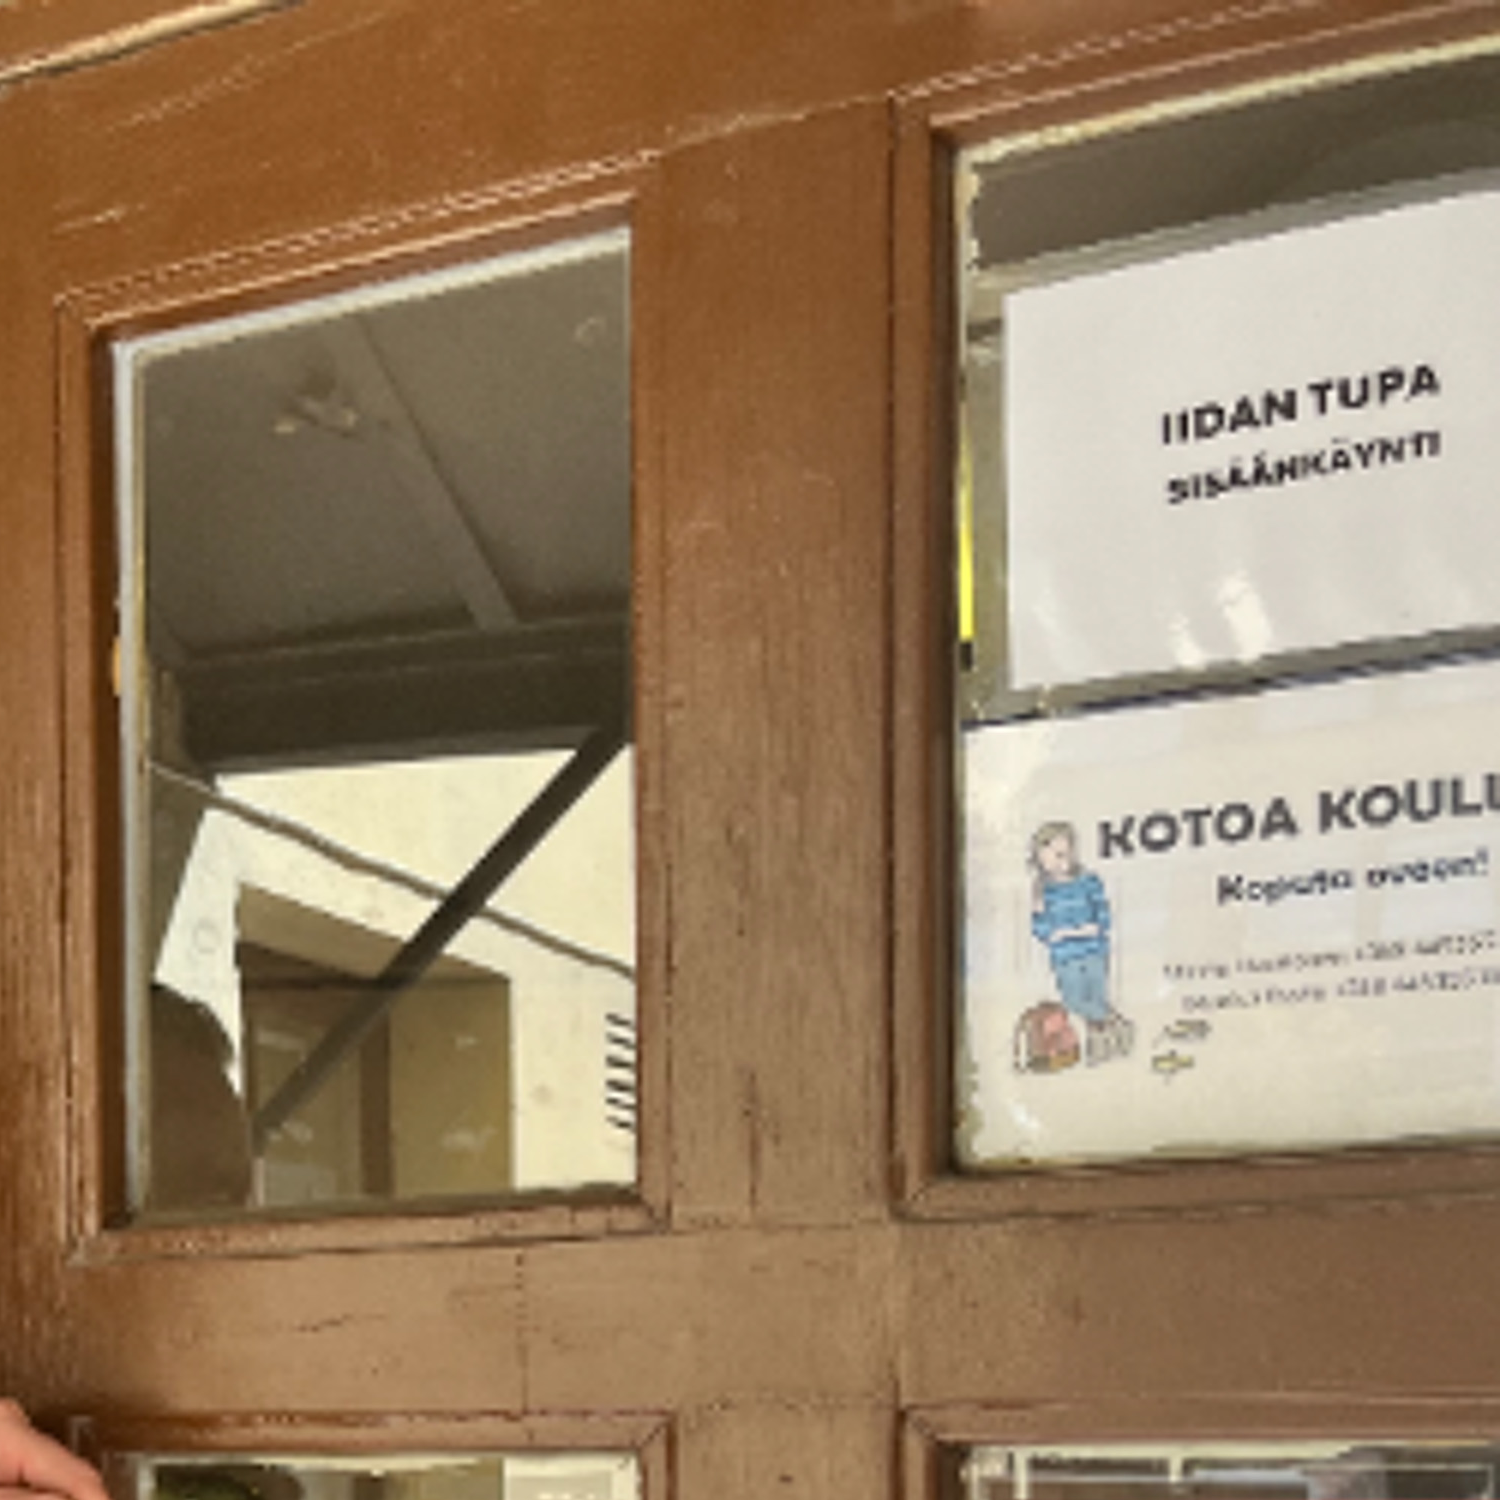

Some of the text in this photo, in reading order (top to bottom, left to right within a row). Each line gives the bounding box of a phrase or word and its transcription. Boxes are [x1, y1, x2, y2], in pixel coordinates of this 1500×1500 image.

[1161, 363, 1441, 445] IIDAN TUPA
[1166, 430, 1441, 504] SISÄÄNKÄYNTI
[1097, 798, 1299, 859] KOTOA
[1217, 848, 1490, 906] Koputa oveen!
